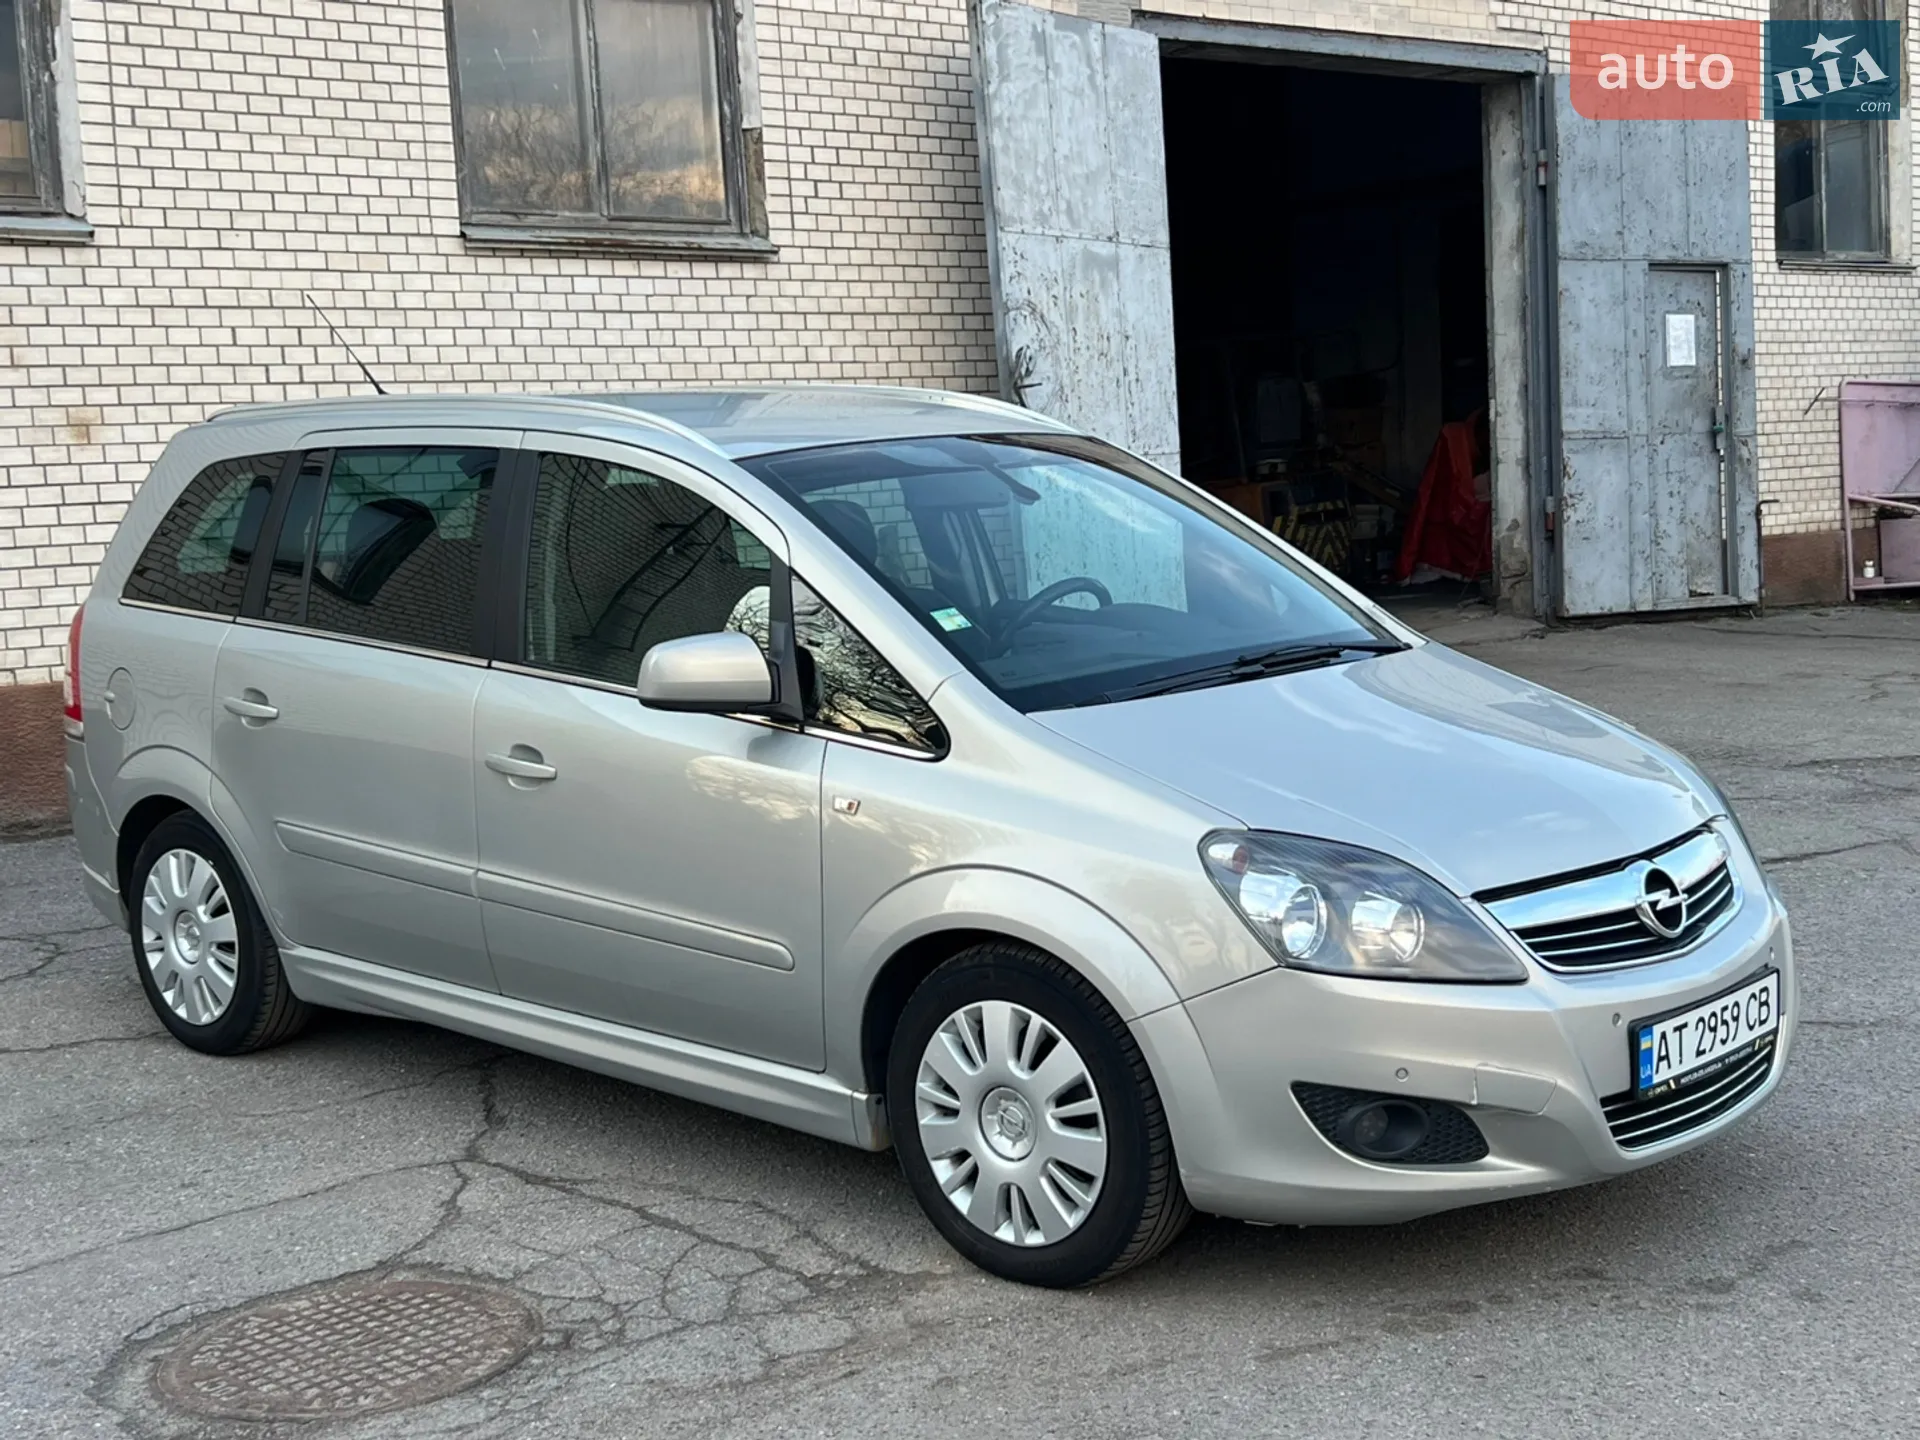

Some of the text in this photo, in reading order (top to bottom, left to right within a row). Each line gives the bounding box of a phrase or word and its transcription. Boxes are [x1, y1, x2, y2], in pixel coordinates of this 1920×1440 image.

[1655, 1022, 1688, 1075] AT
[1694, 1000, 1740, 1058] 2959
[1746, 986, 1771, 1031] CB
[1640, 1064, 1652, 1079] UA
